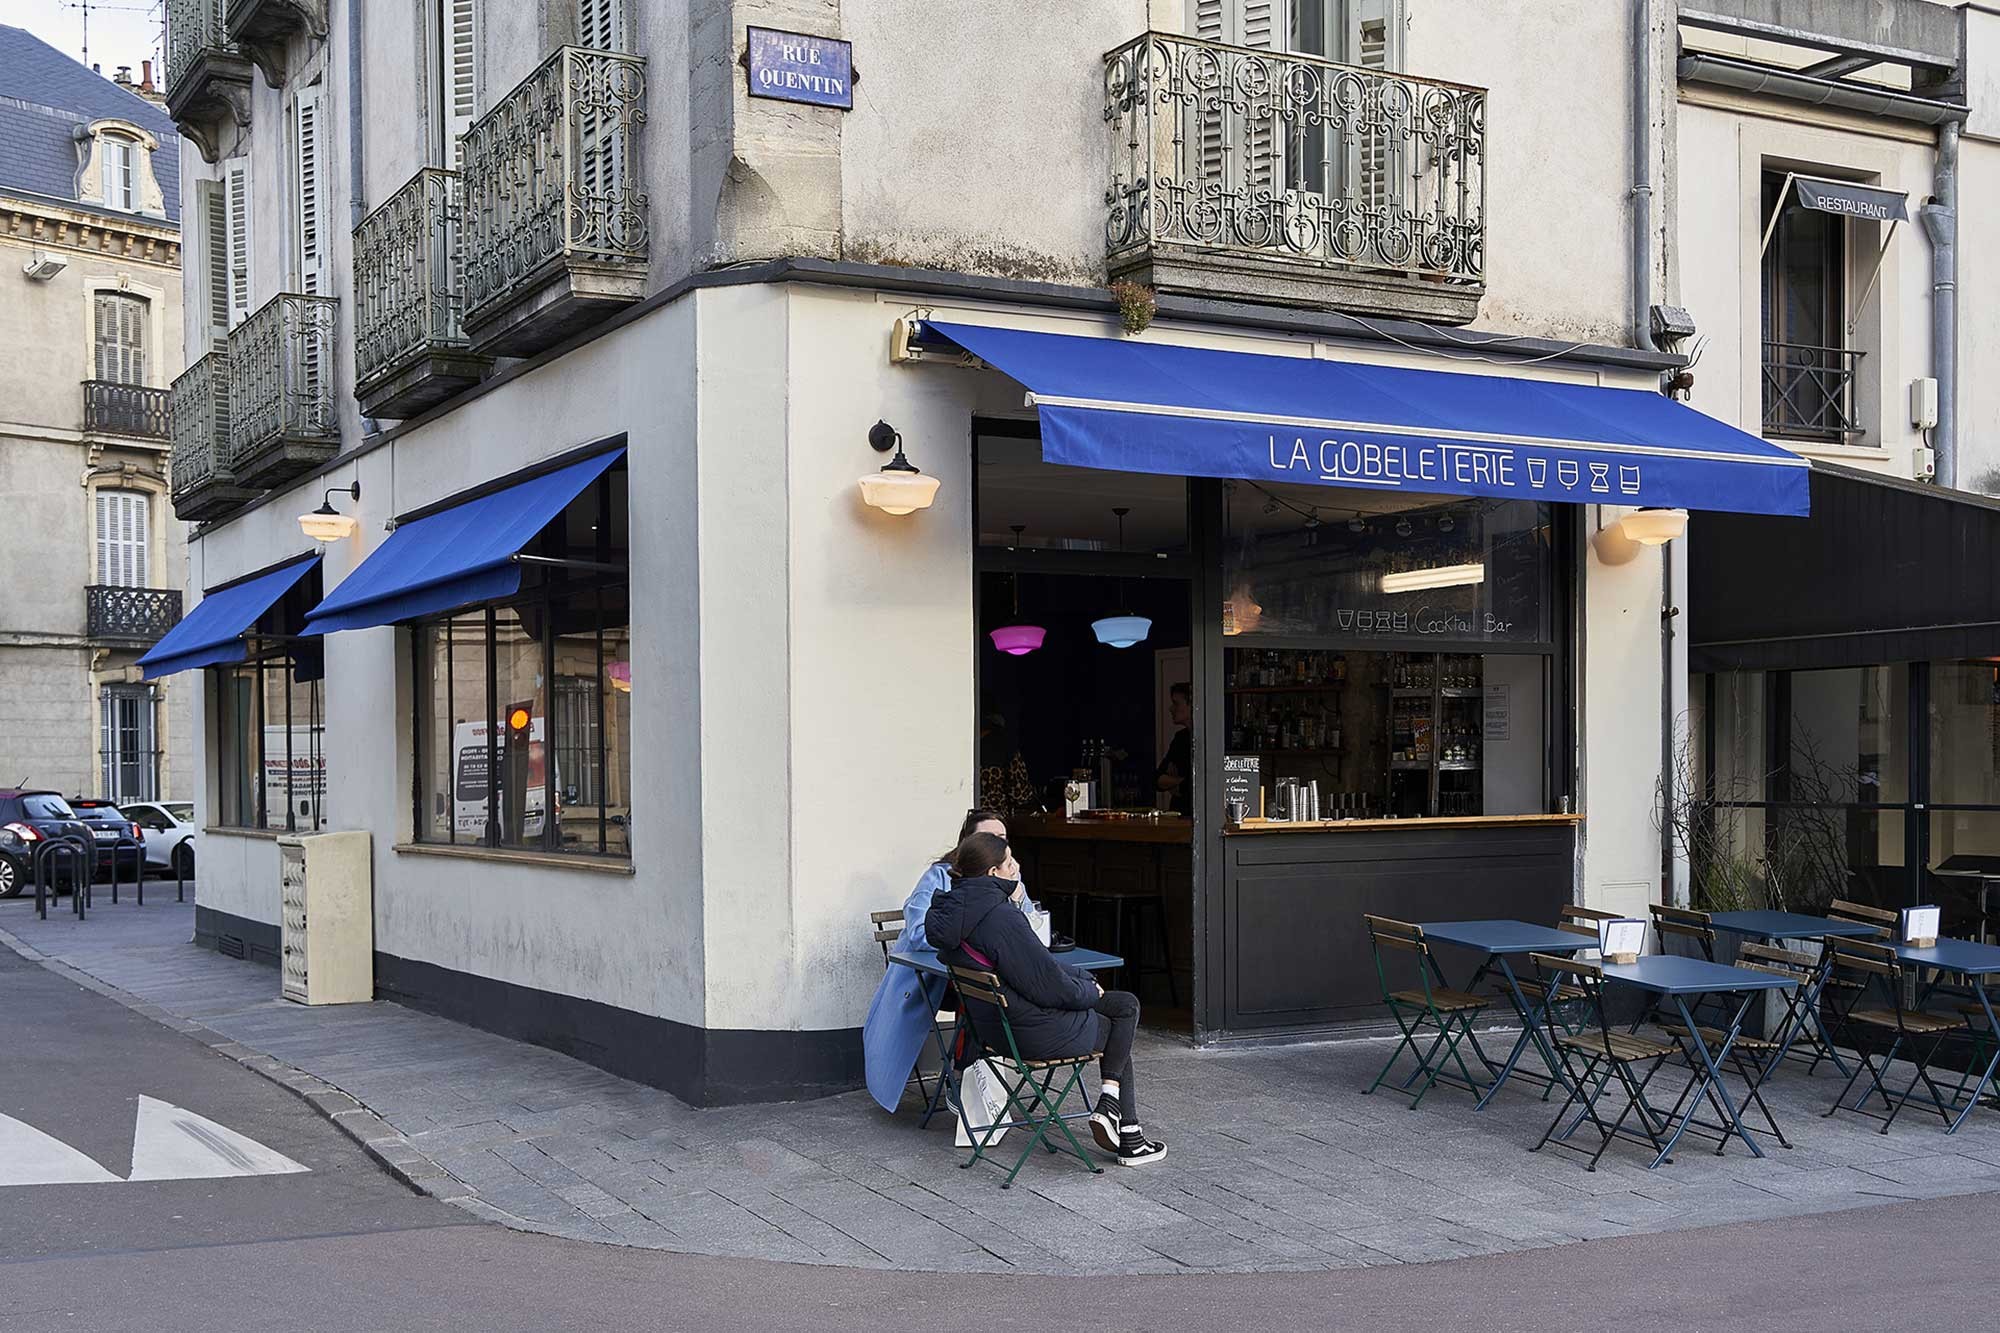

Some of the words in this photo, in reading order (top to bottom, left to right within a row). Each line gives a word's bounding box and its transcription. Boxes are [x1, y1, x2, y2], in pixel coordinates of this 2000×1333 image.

[783, 44, 821, 65] RUE
[759, 68, 843, 96] QUENTIN
[1817, 196, 1887, 218] RESTAURANT
[1269, 435, 1311, 471] LA
[1319, 439, 1516, 486] GOBELETERIE
[1414, 606, 1476, 634] Cocktail
[1483, 612, 1513, 633] Bar
